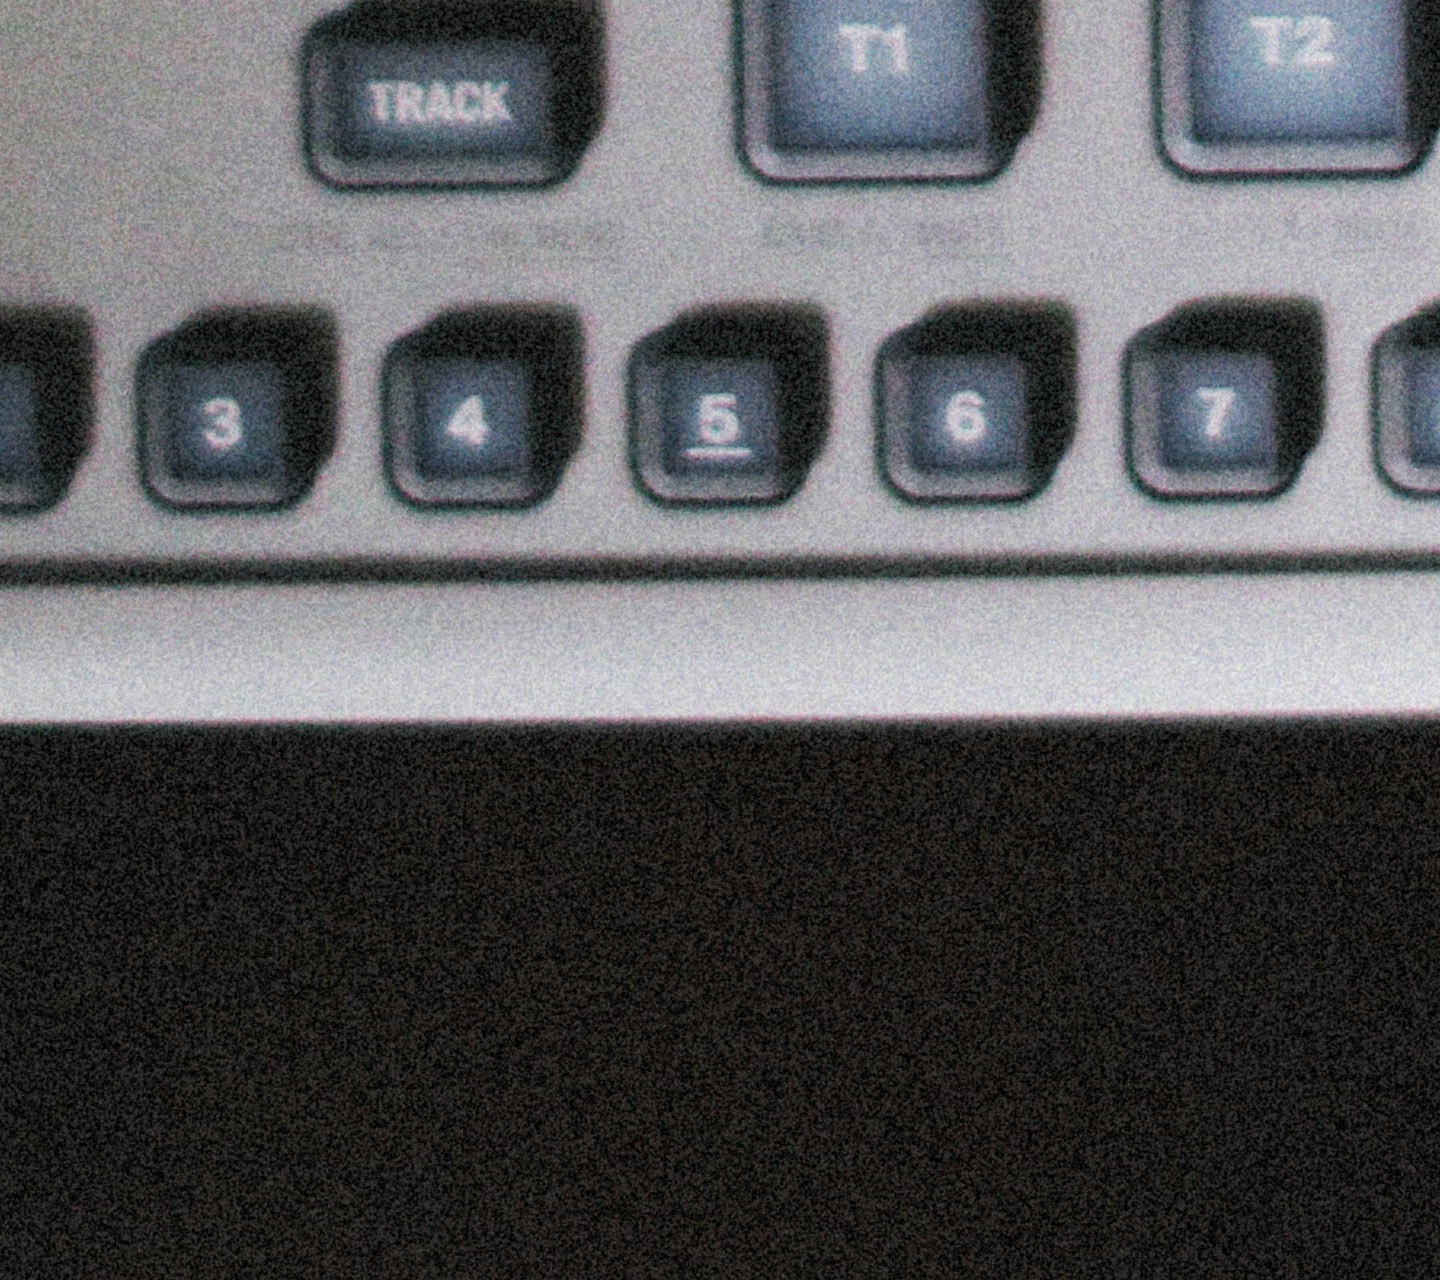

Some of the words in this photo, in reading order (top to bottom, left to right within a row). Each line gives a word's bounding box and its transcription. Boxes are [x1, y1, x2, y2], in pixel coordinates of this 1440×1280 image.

[838, 23, 910, 75] T1
[1250, 15, 1336, 70] T2
[369, 81, 511, 127] TRACK
[202, 397, 242, 451] 3
[445, 396, 490, 447] 4
[698, 393, 740, 443] 5
[943, 391, 988, 446] 6
[1197, 388, 1237, 440] 7
